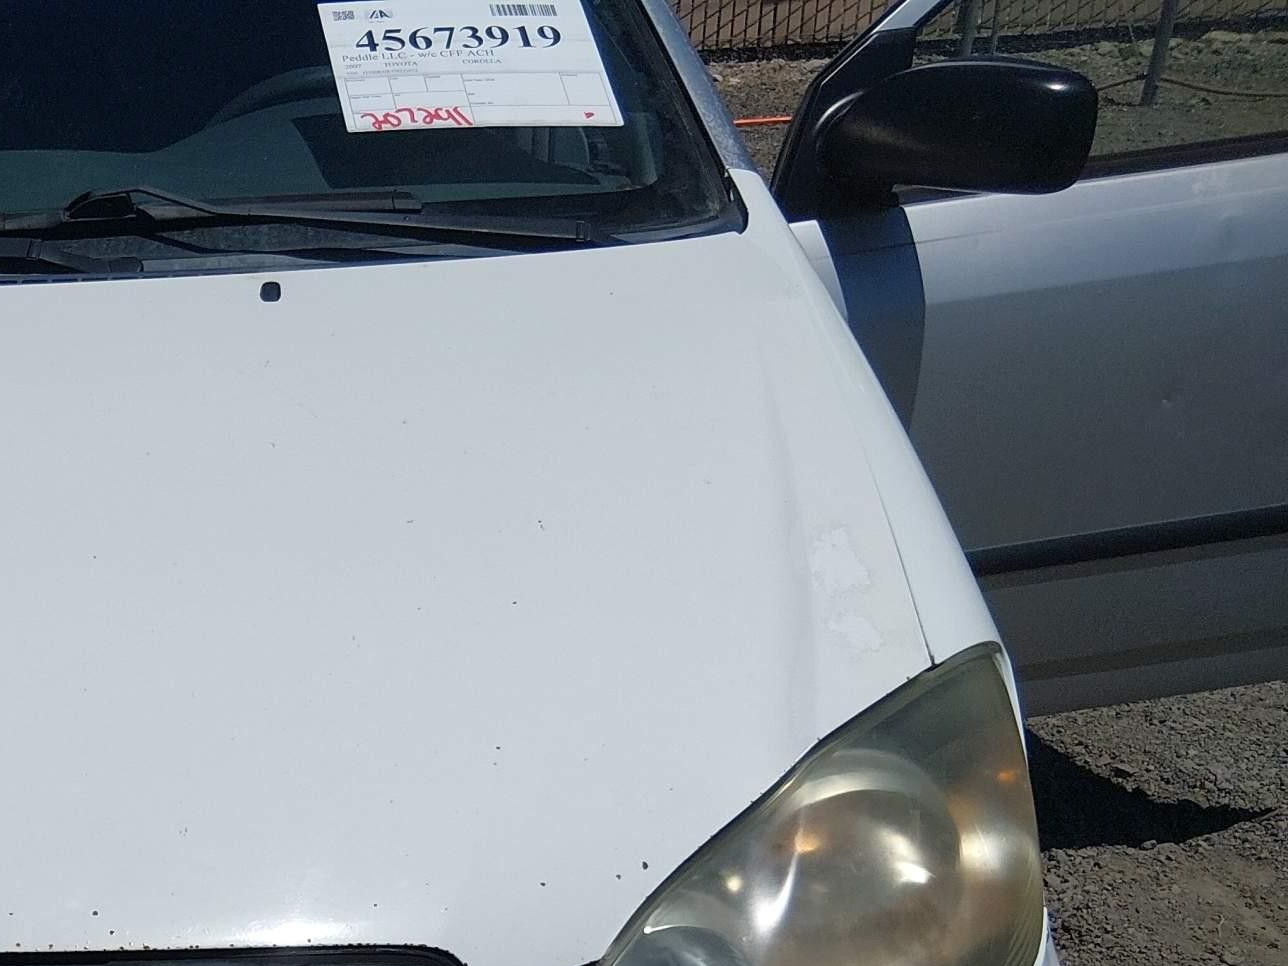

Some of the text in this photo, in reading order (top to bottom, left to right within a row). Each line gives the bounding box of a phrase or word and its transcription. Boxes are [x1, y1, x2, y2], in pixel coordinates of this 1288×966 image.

[356, 25, 561, 52] 45673919
[342, 53, 378, 62] Peddle
[382, 52, 407, 60] LLC
[468, 49, 494, 57] ACH
